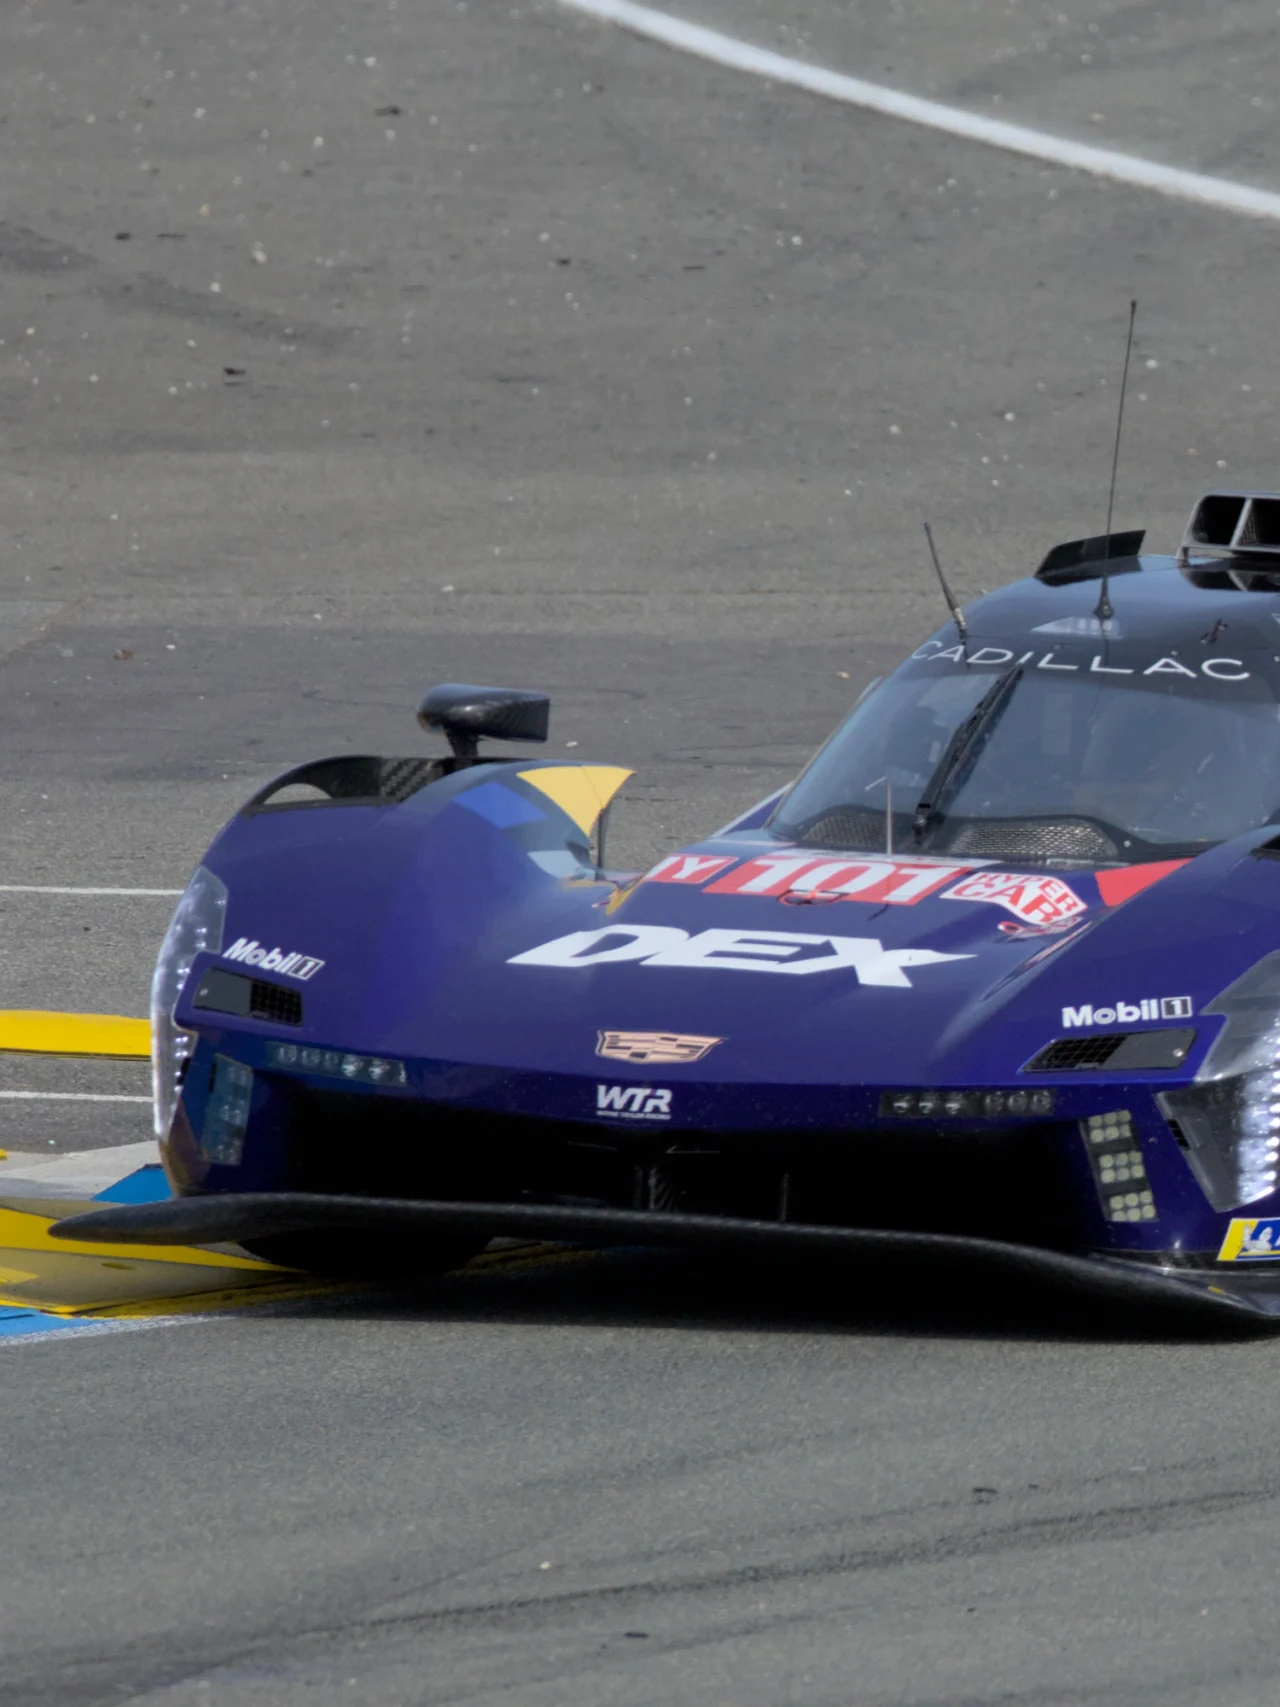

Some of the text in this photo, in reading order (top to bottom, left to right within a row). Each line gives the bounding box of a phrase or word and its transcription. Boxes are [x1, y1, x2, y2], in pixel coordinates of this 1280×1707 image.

[911, 640, 1251, 681] CADILLAC
[736, 858, 960, 903] 101
[973, 873, 1078, 912] HYPER
[953, 882, 1063, 923] CAR
[221, 937, 302, 974] Mobil
[505, 924, 978, 988] DEX
[1062, 999, 1159, 1028] Mobil
[597, 1084, 672, 1113] WTR
